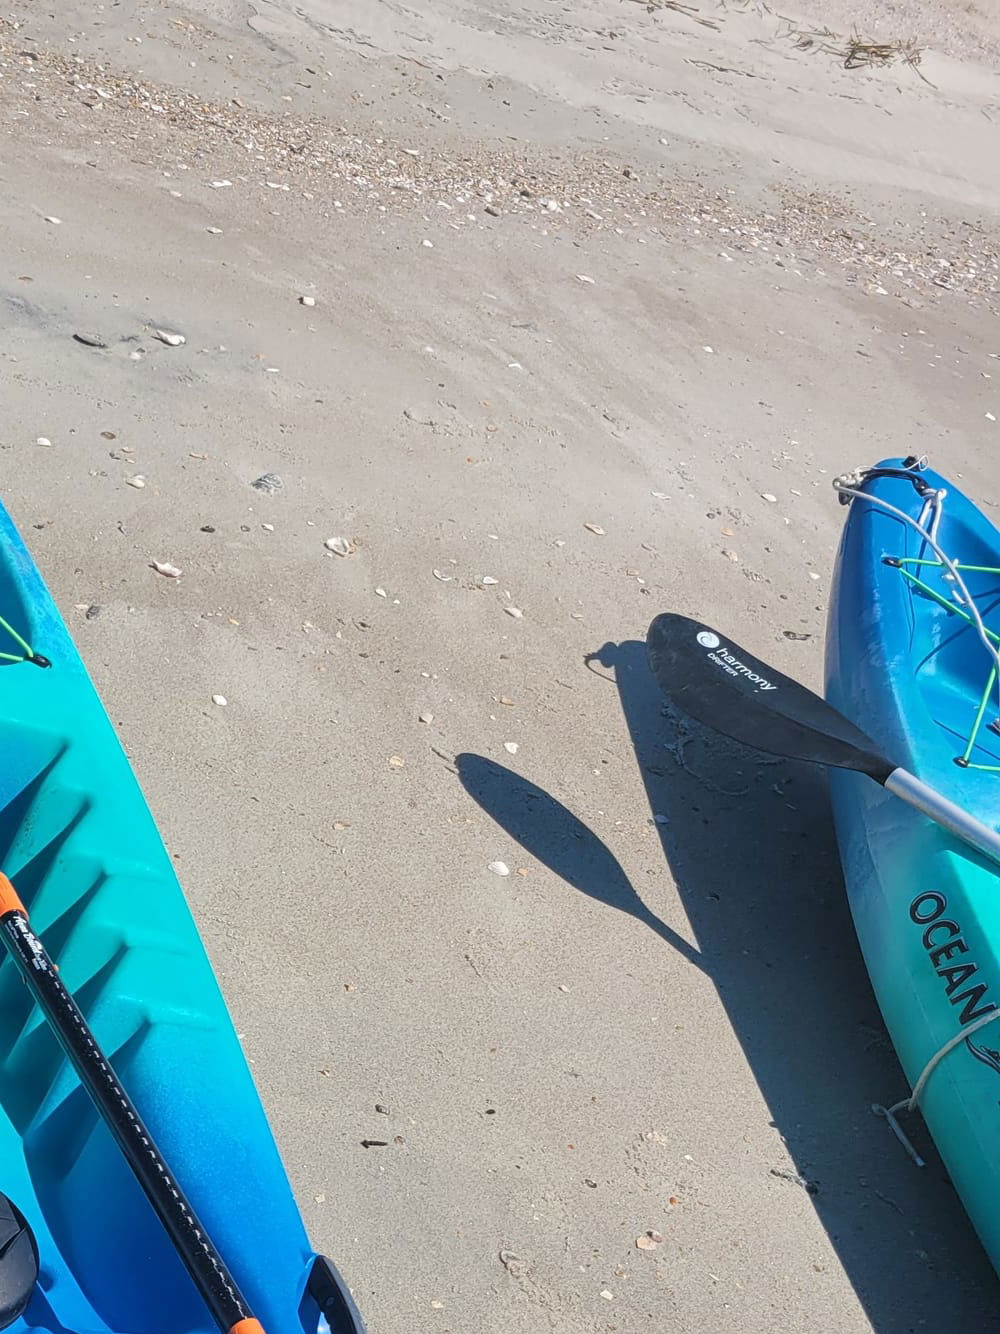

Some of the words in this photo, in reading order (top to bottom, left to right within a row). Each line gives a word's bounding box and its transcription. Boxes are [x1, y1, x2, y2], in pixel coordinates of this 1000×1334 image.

[707, 652, 739, 677] DRIFTER
[716, 647, 777, 691] harmony
[909, 890, 998, 1025] OCEAN
